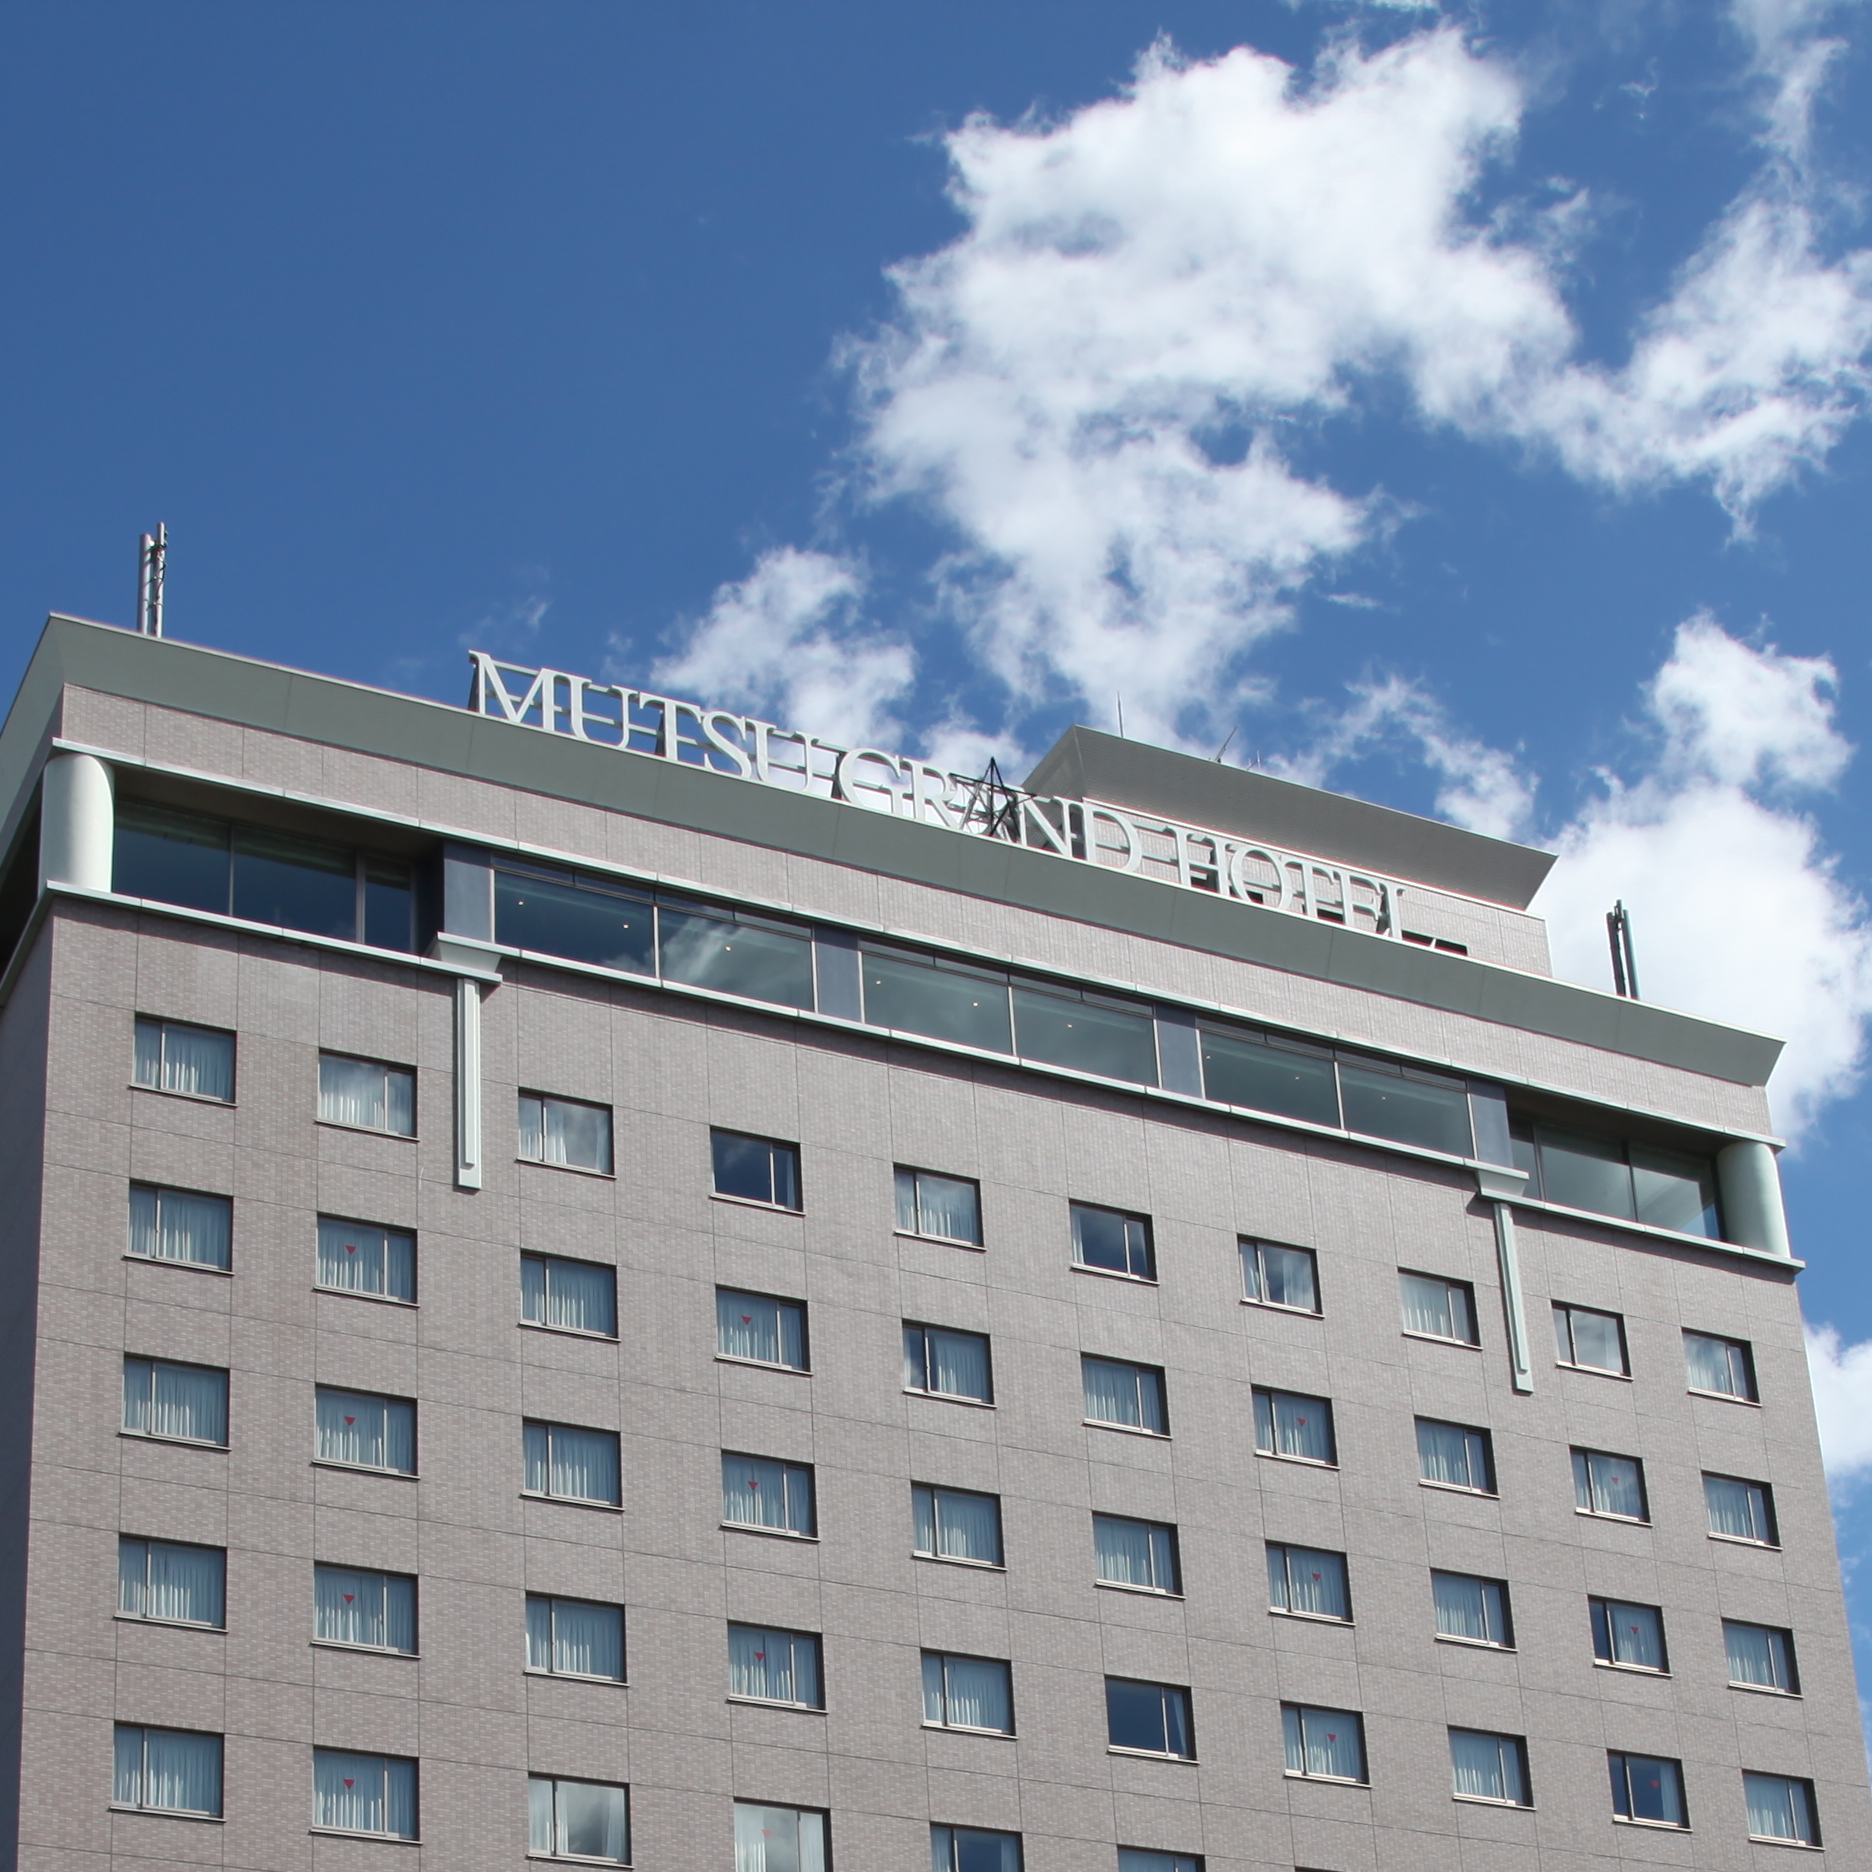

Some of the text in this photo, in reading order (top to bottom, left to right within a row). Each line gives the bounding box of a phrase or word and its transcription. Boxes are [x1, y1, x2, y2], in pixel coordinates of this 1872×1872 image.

[469, 649, 1439, 948] MUTSU GRAND HOTEL
